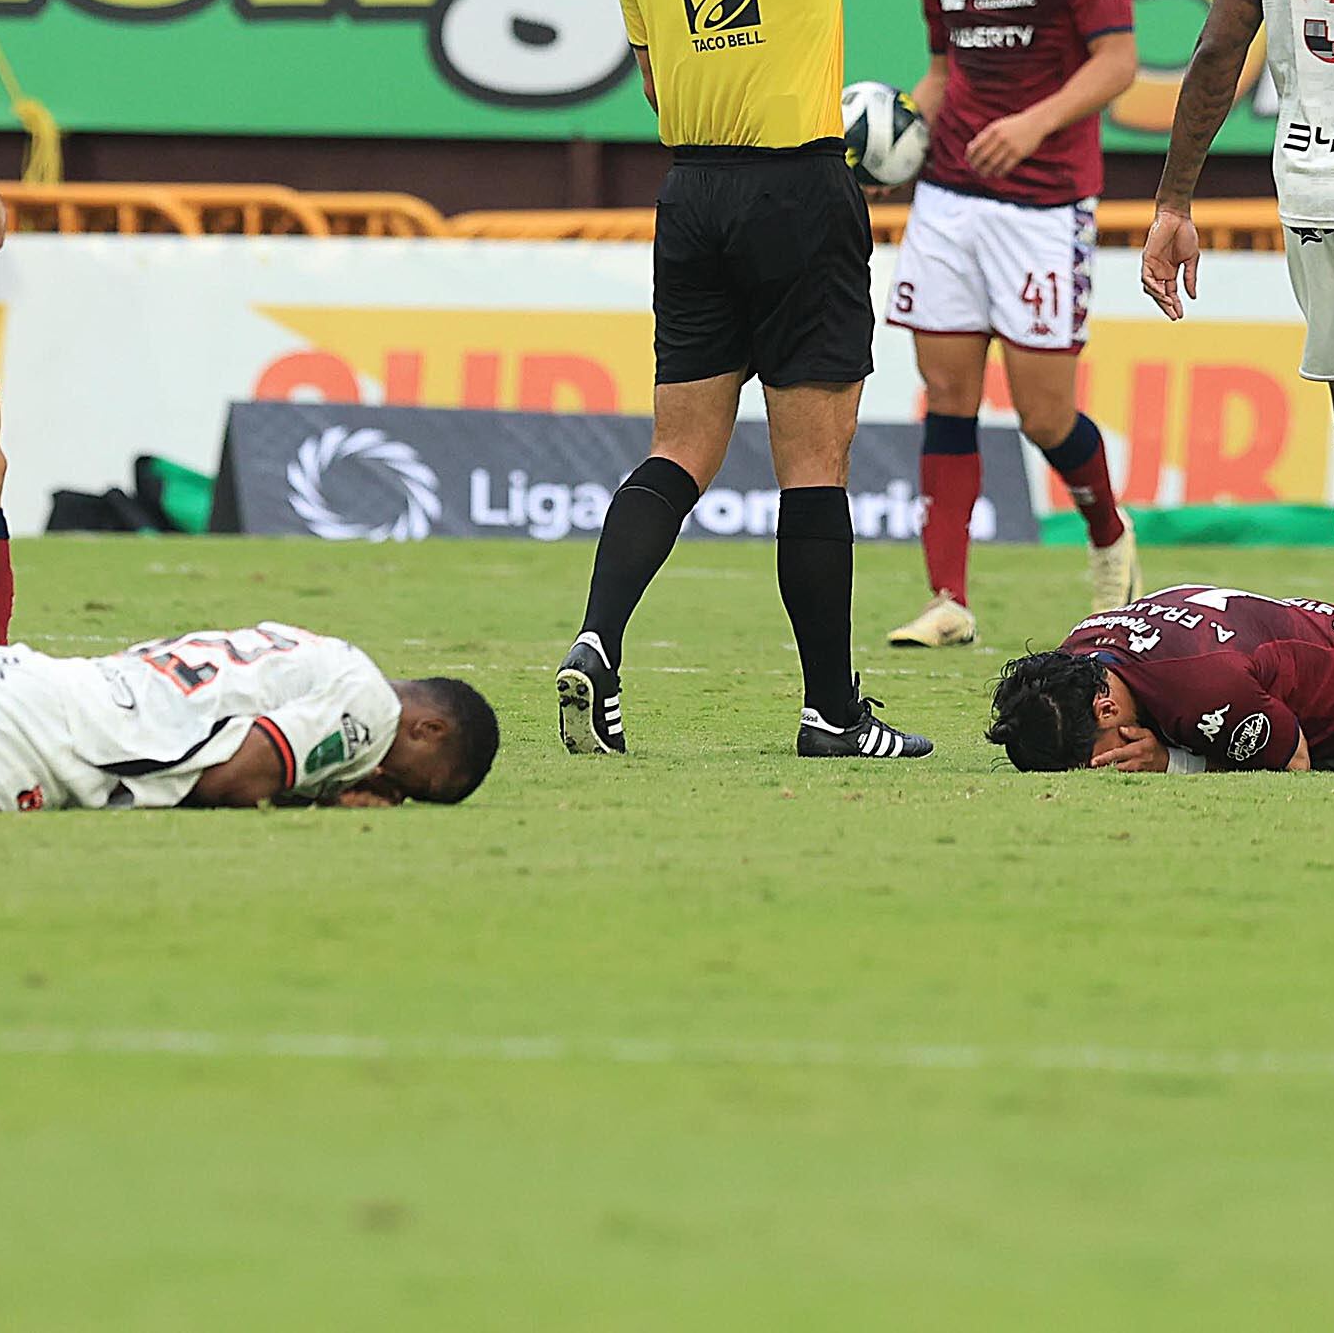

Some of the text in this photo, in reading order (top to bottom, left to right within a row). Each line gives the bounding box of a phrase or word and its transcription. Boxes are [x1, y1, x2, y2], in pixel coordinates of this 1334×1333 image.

[692, 30, 765, 54] TACO BELL
[896, 280, 915, 314] S
[1021, 271, 1059, 319] 41
